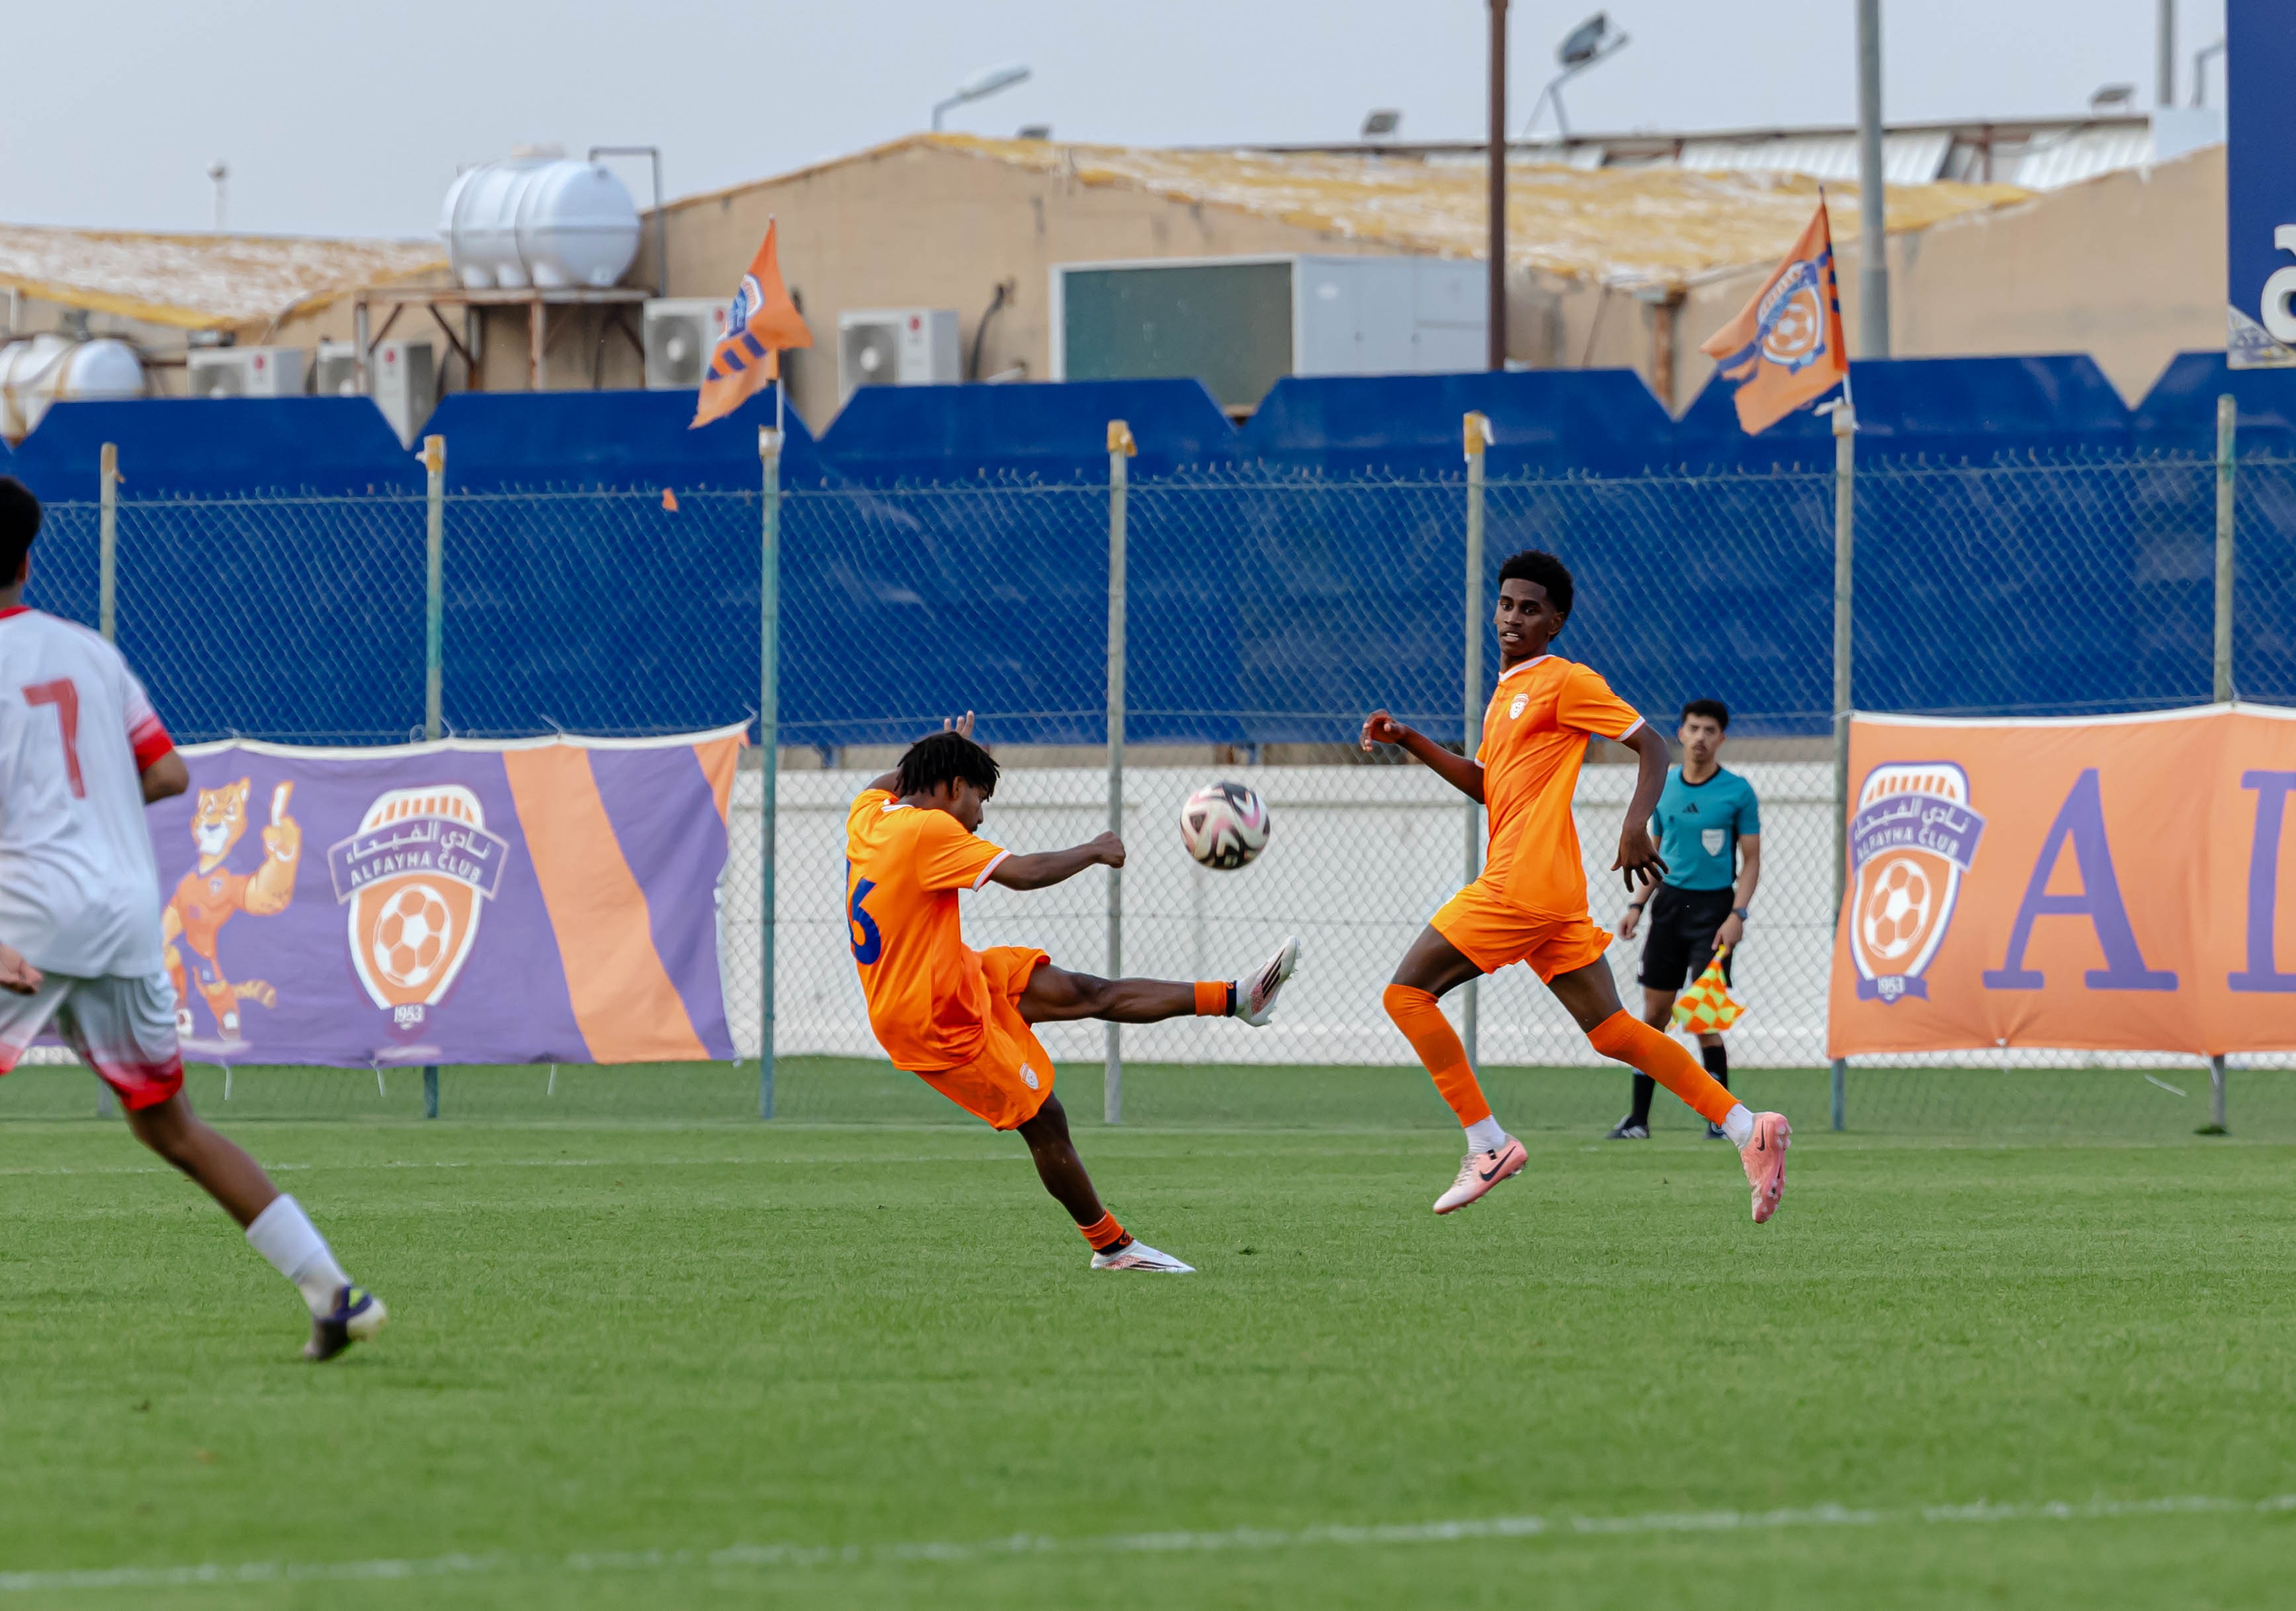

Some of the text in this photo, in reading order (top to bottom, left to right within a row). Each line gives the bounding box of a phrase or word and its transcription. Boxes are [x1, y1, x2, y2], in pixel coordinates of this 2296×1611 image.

[21, 677, 86, 800] 7
[1922, 806, 1971, 834] نادي
[346, 820, 491, 865] نادي الفيحاء
[1918, 828, 1960, 858] CLUB
[350, 851, 483, 887] ALFAYHA CLUB
[847, 858, 881, 965] 6
[394, 1005, 425, 1023] 1953
